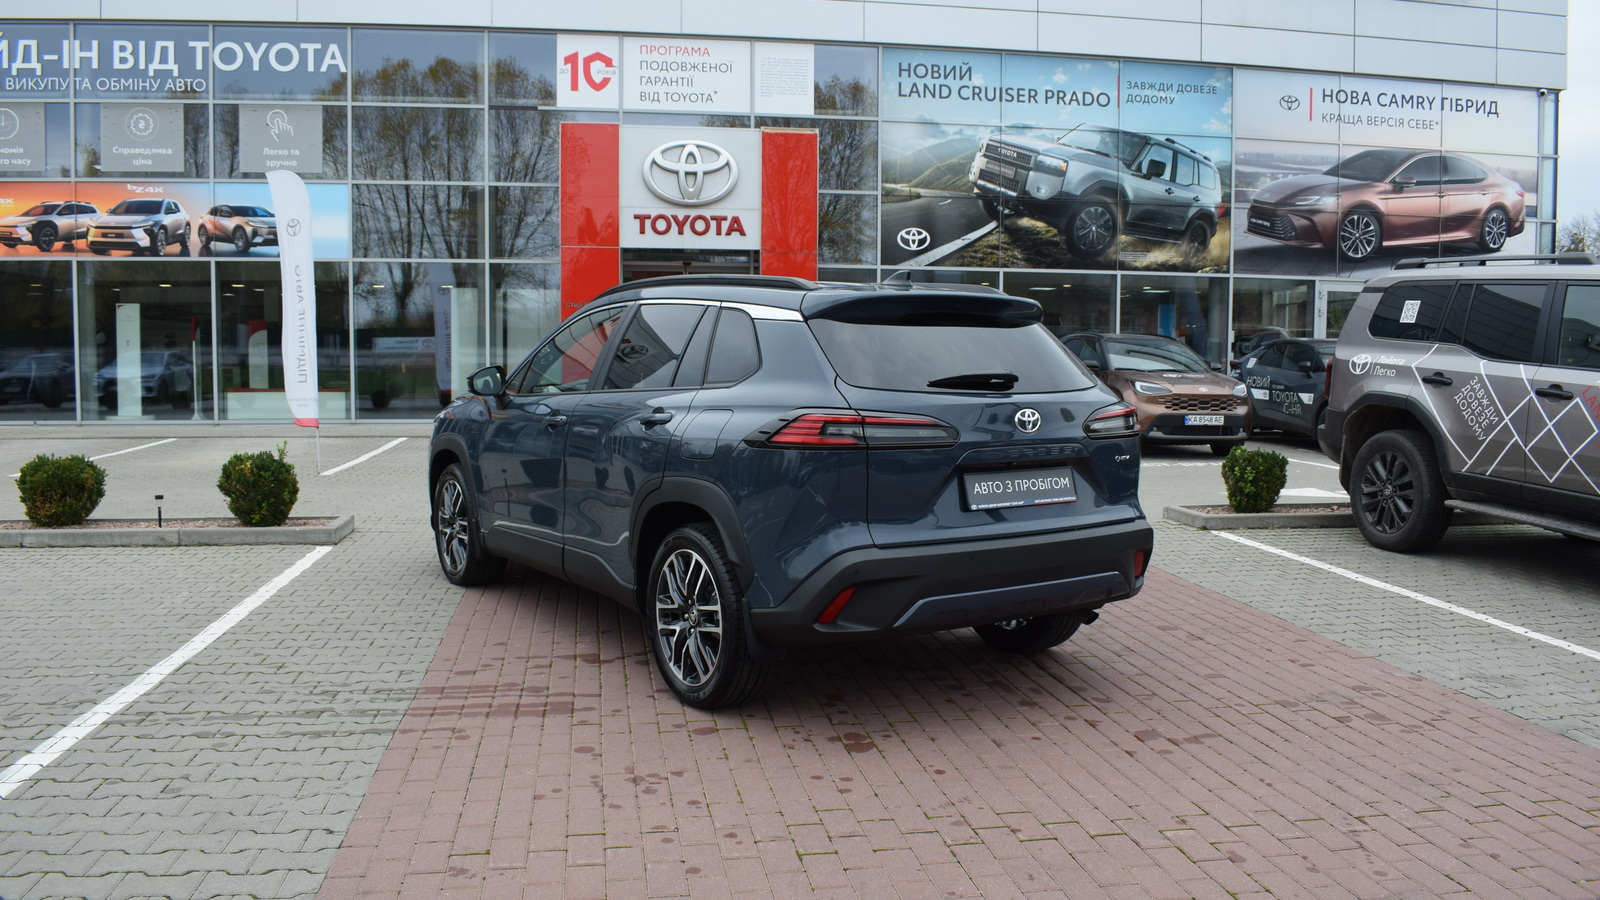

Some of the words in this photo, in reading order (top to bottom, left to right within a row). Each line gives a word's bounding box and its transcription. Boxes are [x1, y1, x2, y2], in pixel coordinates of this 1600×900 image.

[640, 45, 710, 57] ПРОГРАМА
[113, 40, 178, 76] ВІД
[188, 41, 347, 72] TOYOTA
[640, 60, 734, 74] ПОДОВЖЕНОЇ
[898, 62, 973, 81] НОВИЙ
[6, 77, 69, 90] ВИКУПУ
[74, 77, 92, 90] ТА
[96, 78, 161, 92] ОБМІНУ
[165, 79, 206, 92] АВТО
[640, 75, 694, 87] ГАРАНТІЇ
[1126, 80, 1173, 93] ЗАВЖДИ
[1176, 83, 1218, 95] ДОВЕЗЕ
[640, 91, 661, 104] ВІД
[898, 82, 952, 100] LAND
[957, 85, 1039, 104] CRUISER
[1044, 89, 1111, 108] PRADO
[1126, 94, 1175, 105] ДОДОМУ
[1322, 88, 1371, 106] НОВА
[1377, 92, 1436, 111] CAMRY
[1441, 97, 1499, 118] ГІБРИД
[1321, 113, 1363, 126] КРАЩА
[1366, 115, 1404, 128] ВЕРСІЯ
[112, 146, 172, 155] Справедлива
[11, 158, 31, 166] часу
[133, 157, 152, 166] ціна
[265, 160, 298, 168] зручно
[633, 213, 747, 237] TOYOTA
[1377, 355, 1405, 366] Тойота
[1373, 365, 1396, 376] Легко
[1246, 376, 1271, 388] НОВИЙ
[1272, 390, 1299, 403] TOYOTA
[1470, 375, 1499, 425] ЗАВЖДИ
[1283, 403, 1302, 415] C-HR
[1461, 384, 1490, 429] ДОВЕЗЕ
[1453, 392, 1487, 440] ДОДОМУ
[974, 480, 1003, 495] АВТО
[1015, 477, 1070, 492] ПРОБІГОМ
